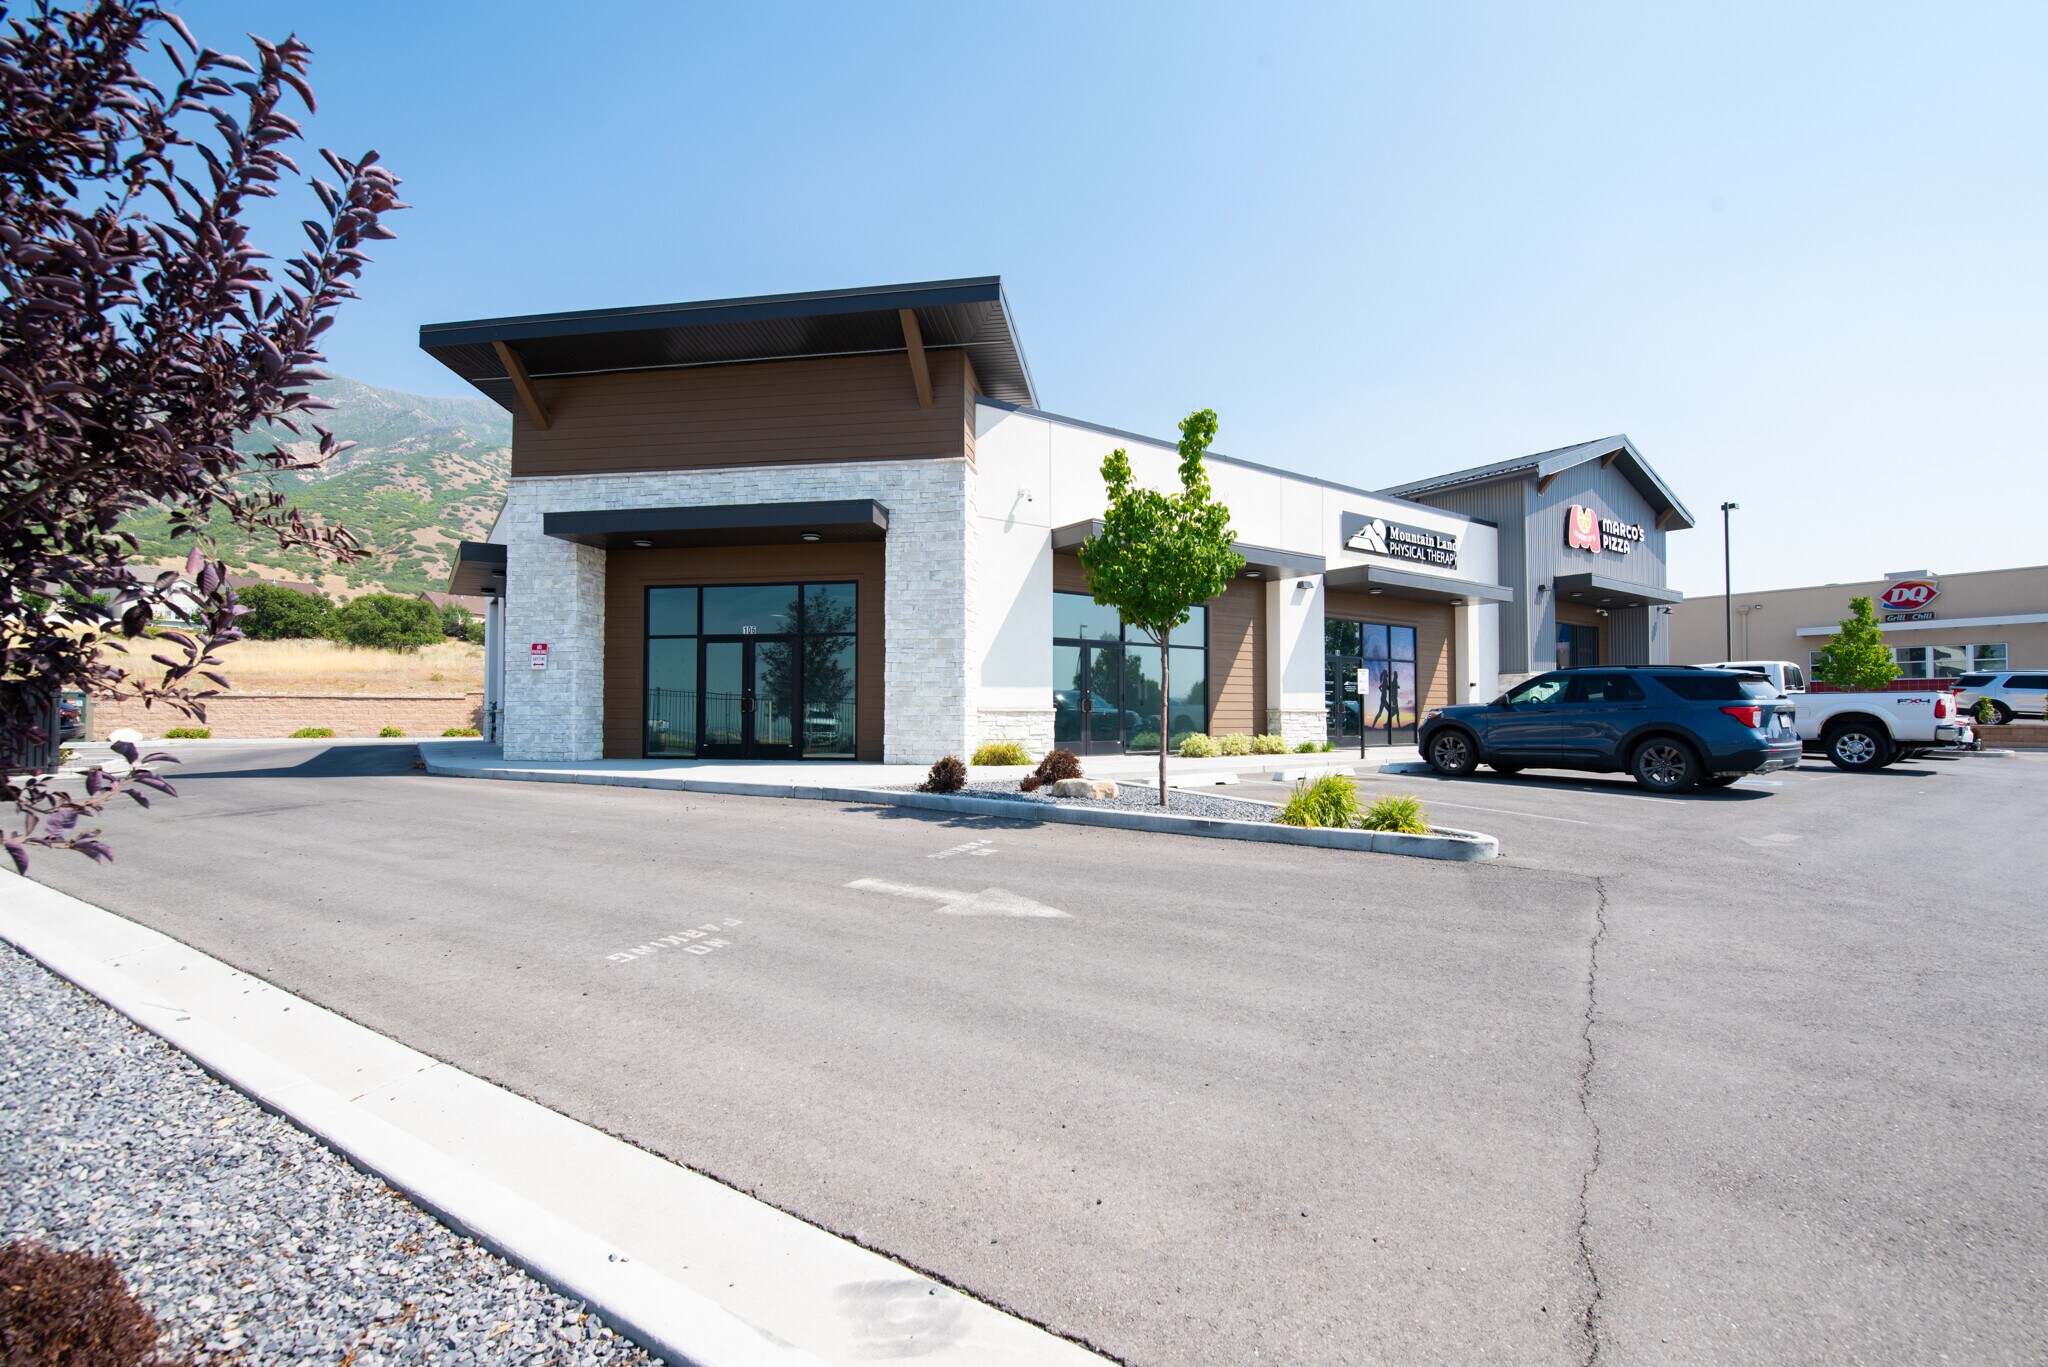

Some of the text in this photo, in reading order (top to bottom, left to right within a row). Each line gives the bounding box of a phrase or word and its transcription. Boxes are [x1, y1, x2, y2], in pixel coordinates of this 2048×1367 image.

[1389, 525, 1457, 552] Mountain Land
[1602, 518, 1645, 542] MARCO'S
[1389, 541, 1426, 560] PHYSICAL
[1603, 534, 1630, 554] PIZZA
[1890, 586, 1928, 603] DQ
[743, 626, 756, 634] 106
